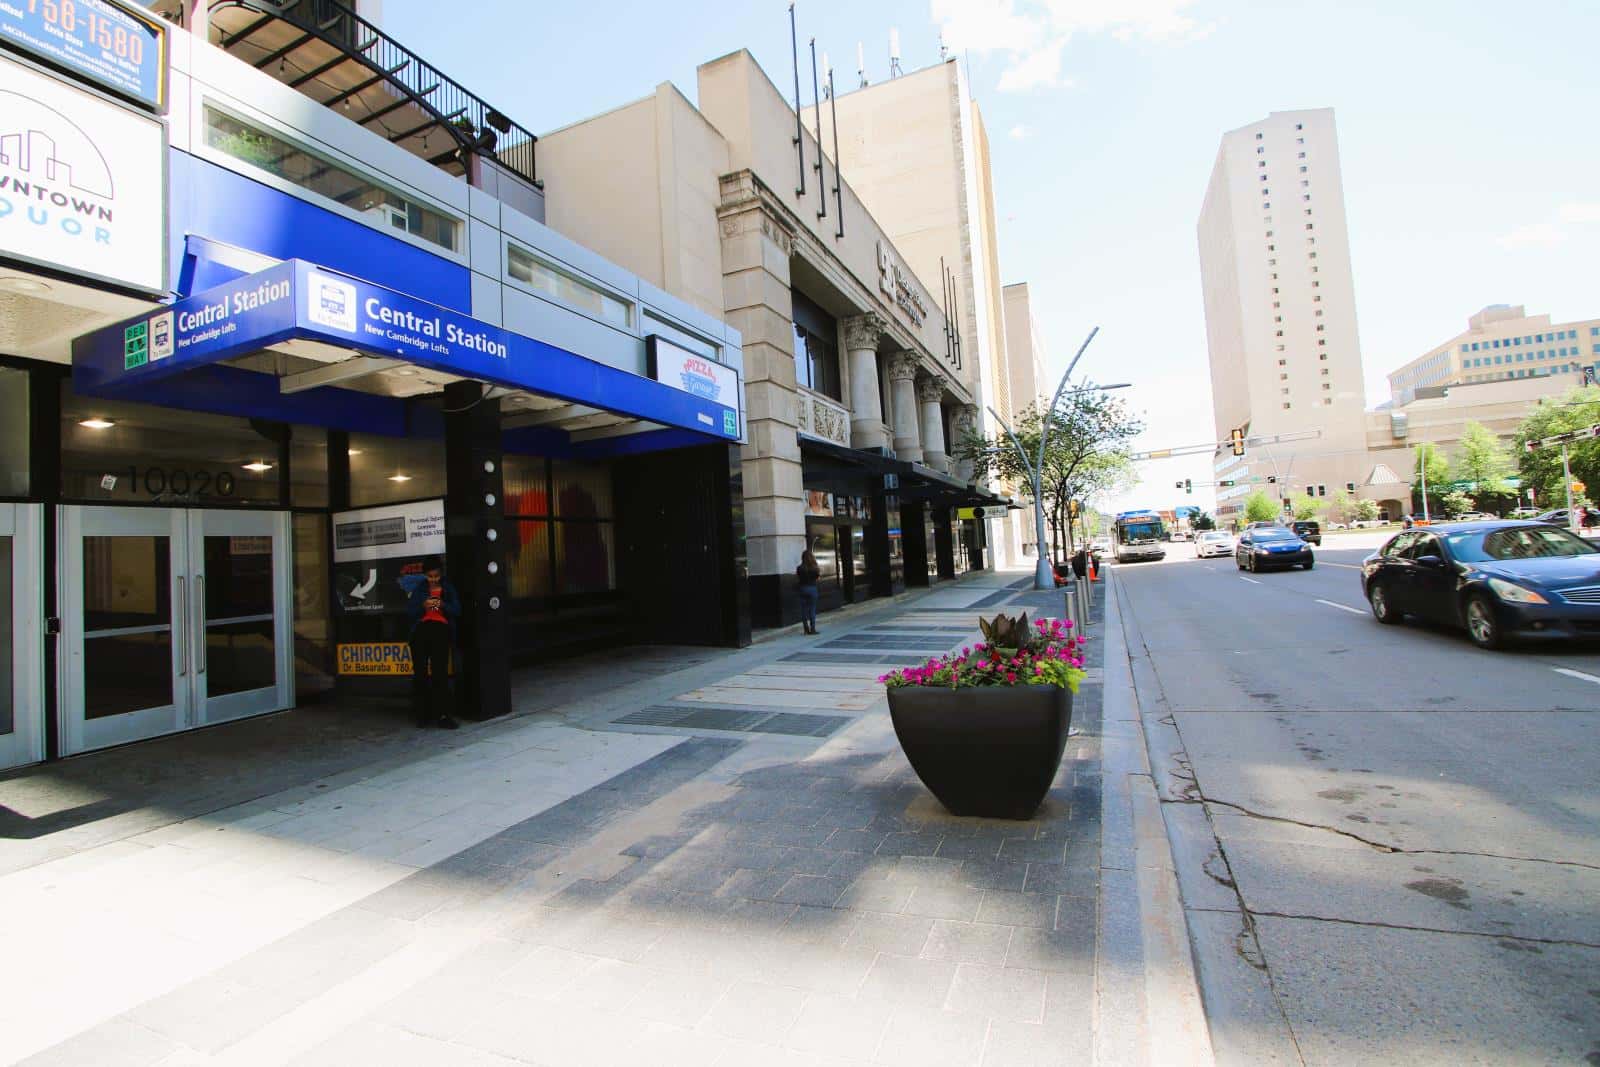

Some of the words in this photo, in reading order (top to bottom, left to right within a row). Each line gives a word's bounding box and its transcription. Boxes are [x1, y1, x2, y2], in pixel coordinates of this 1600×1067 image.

[178, 295, 230, 333] Central
[233, 279, 290, 315] Station
[364, 322, 385, 337] New
[386, 329, 429, 350] Cambridge
[430, 342, 450, 355] Lofts
[365, 298, 440, 339] Central
[446, 322, 507, 359] Station
[129, 465, 234, 496] 10020
[342, 645, 411, 662] CHIROPRA
